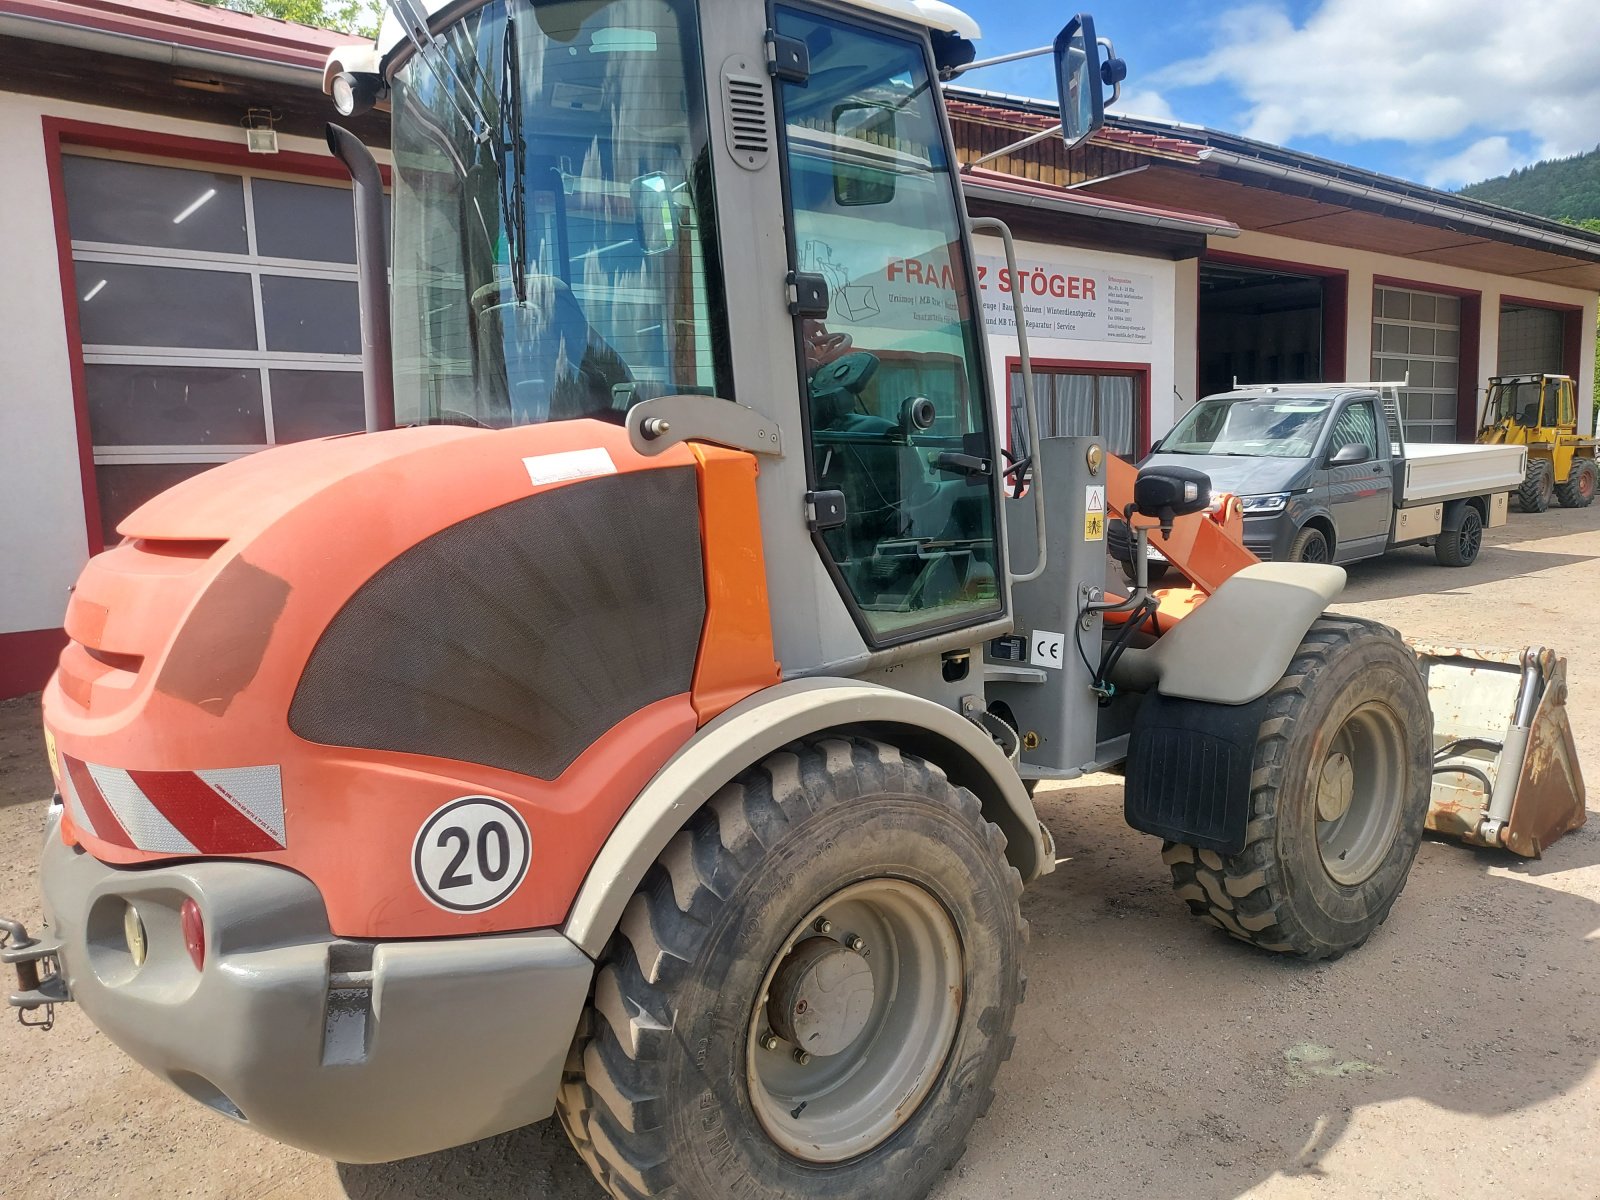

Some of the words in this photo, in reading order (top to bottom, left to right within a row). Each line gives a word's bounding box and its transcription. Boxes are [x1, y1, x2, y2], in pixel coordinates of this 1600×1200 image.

[998, 267, 1096, 300] STÖGER
[1056, 322, 1076, 331] Service
[1037, 641, 1058, 659] CE
[437, 820, 510, 890] 20
